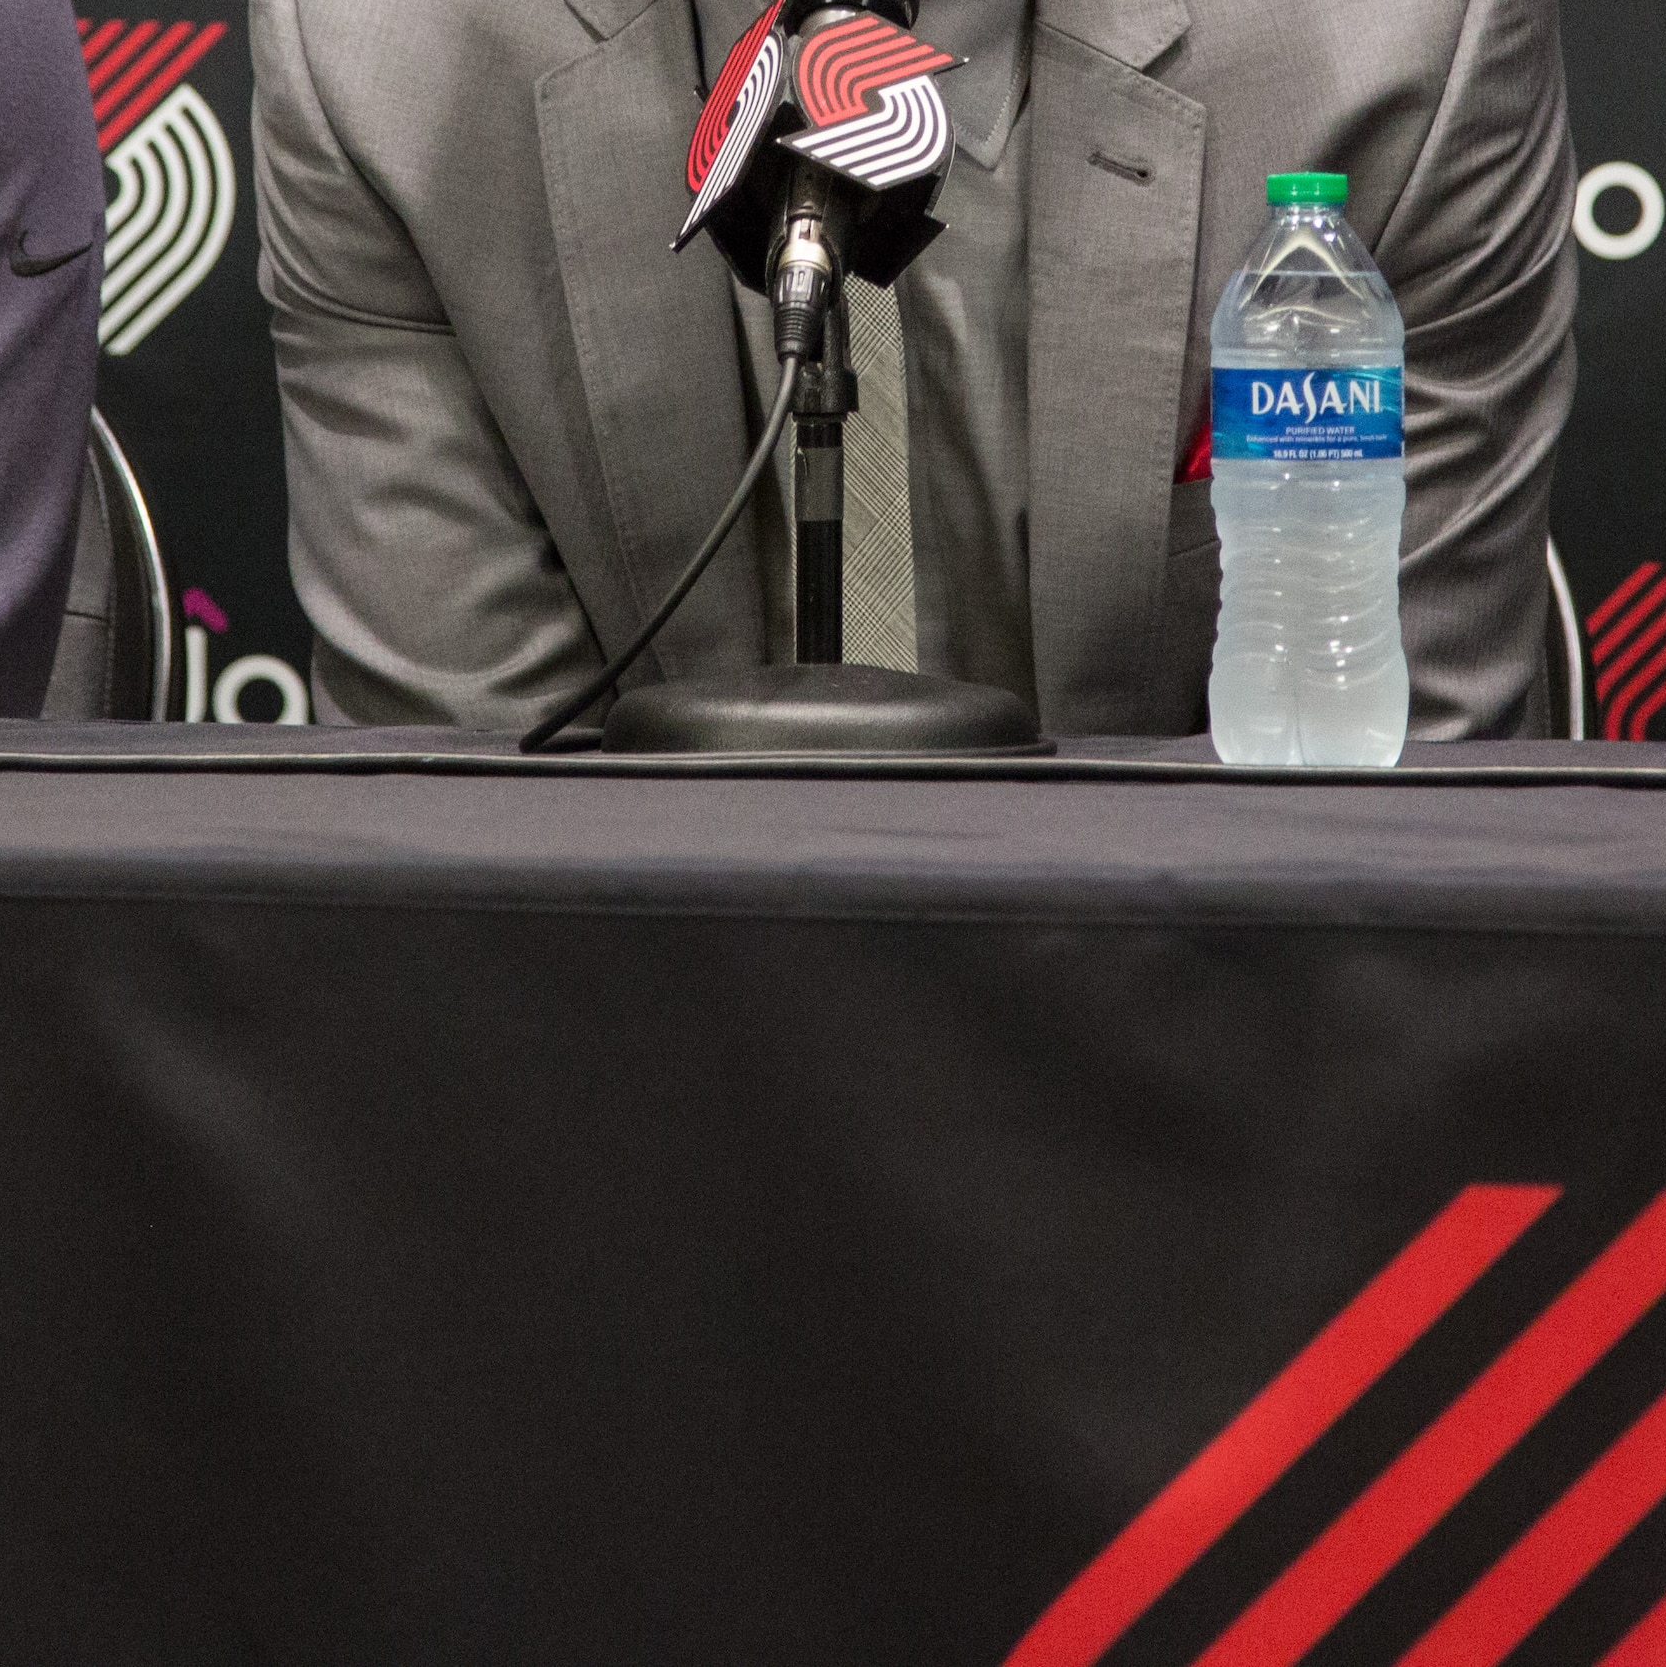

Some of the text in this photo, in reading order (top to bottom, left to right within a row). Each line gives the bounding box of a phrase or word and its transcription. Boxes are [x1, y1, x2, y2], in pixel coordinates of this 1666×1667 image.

[1251, 370, 1382, 425] DASANI
[1285, 426, 1355, 435] PURIFIED WATER
